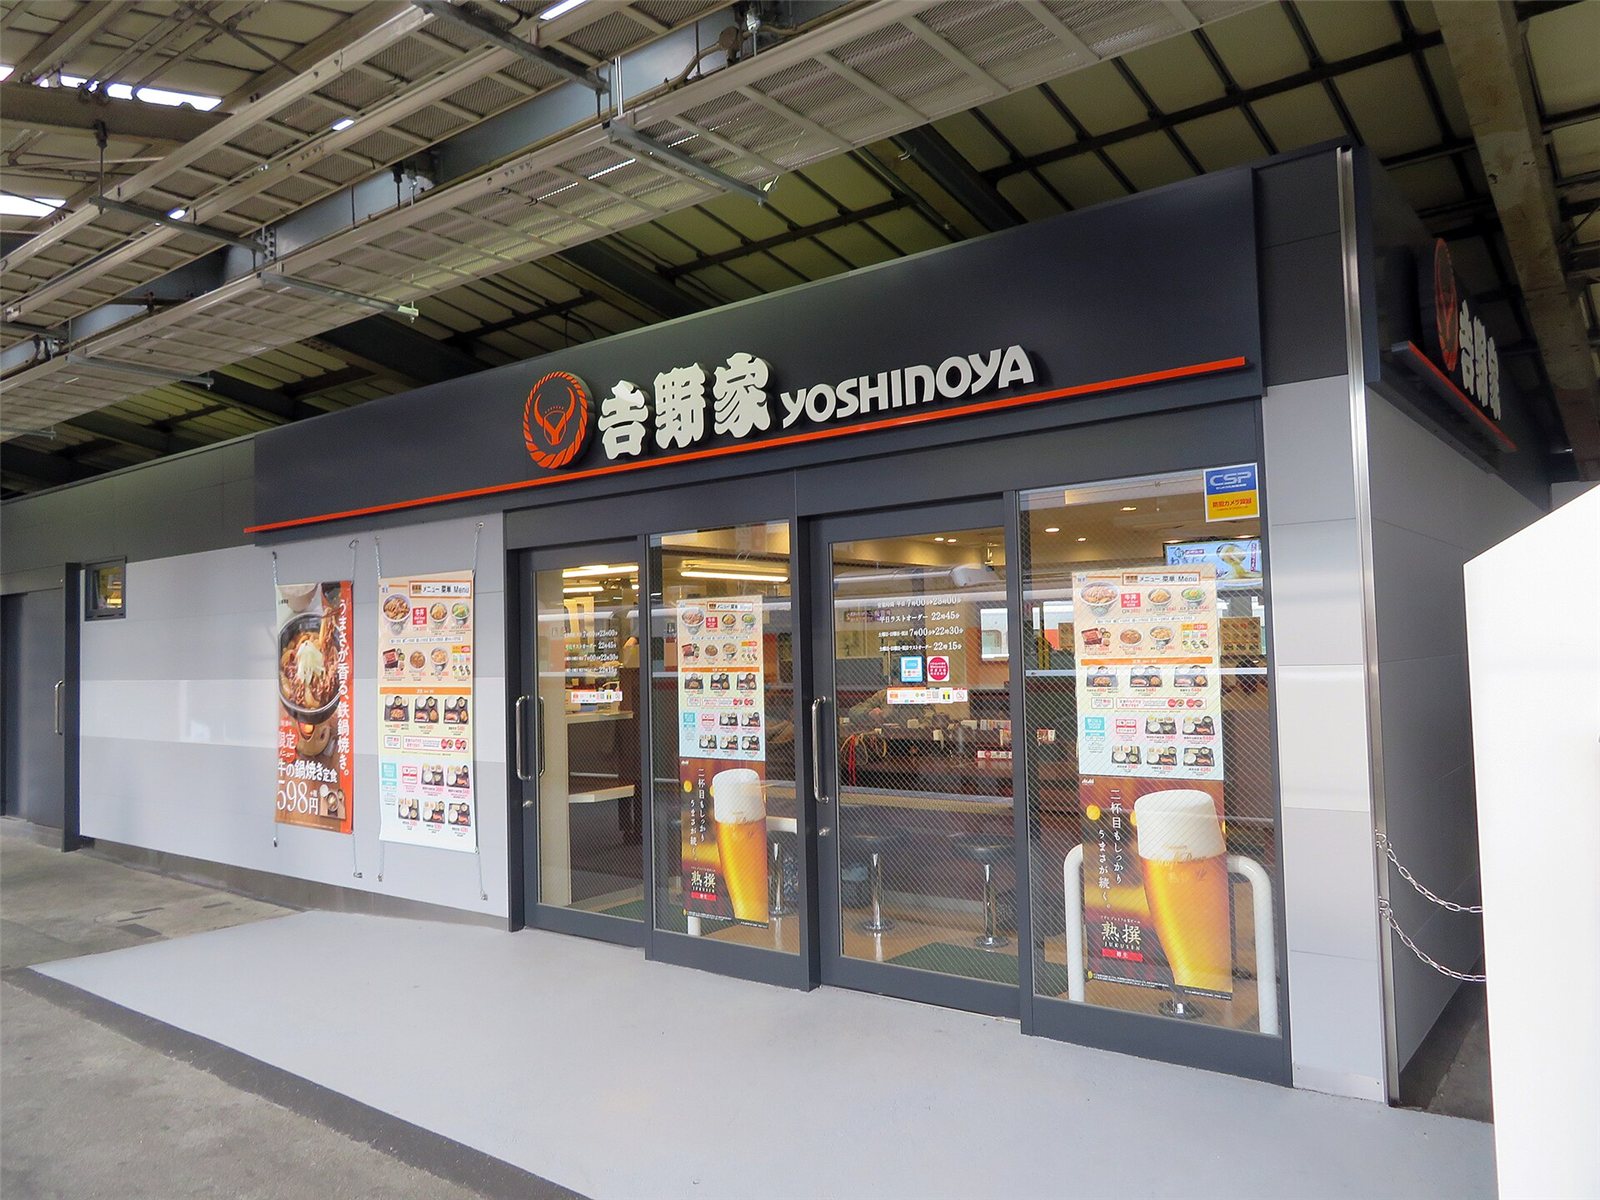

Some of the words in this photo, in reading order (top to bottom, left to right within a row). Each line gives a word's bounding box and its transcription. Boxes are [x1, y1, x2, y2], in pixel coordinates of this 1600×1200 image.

[779, 344, 1036, 428] YOSHINOYA
[1209, 471, 1252, 487] CSP
[1178, 575, 1198, 583] Menu
[1110, 788, 1124, 884] 二杯目もしっかり
[1098, 829, 1111, 909] うまさが続く。
[1101, 921, 1142, 945] 熟撰
